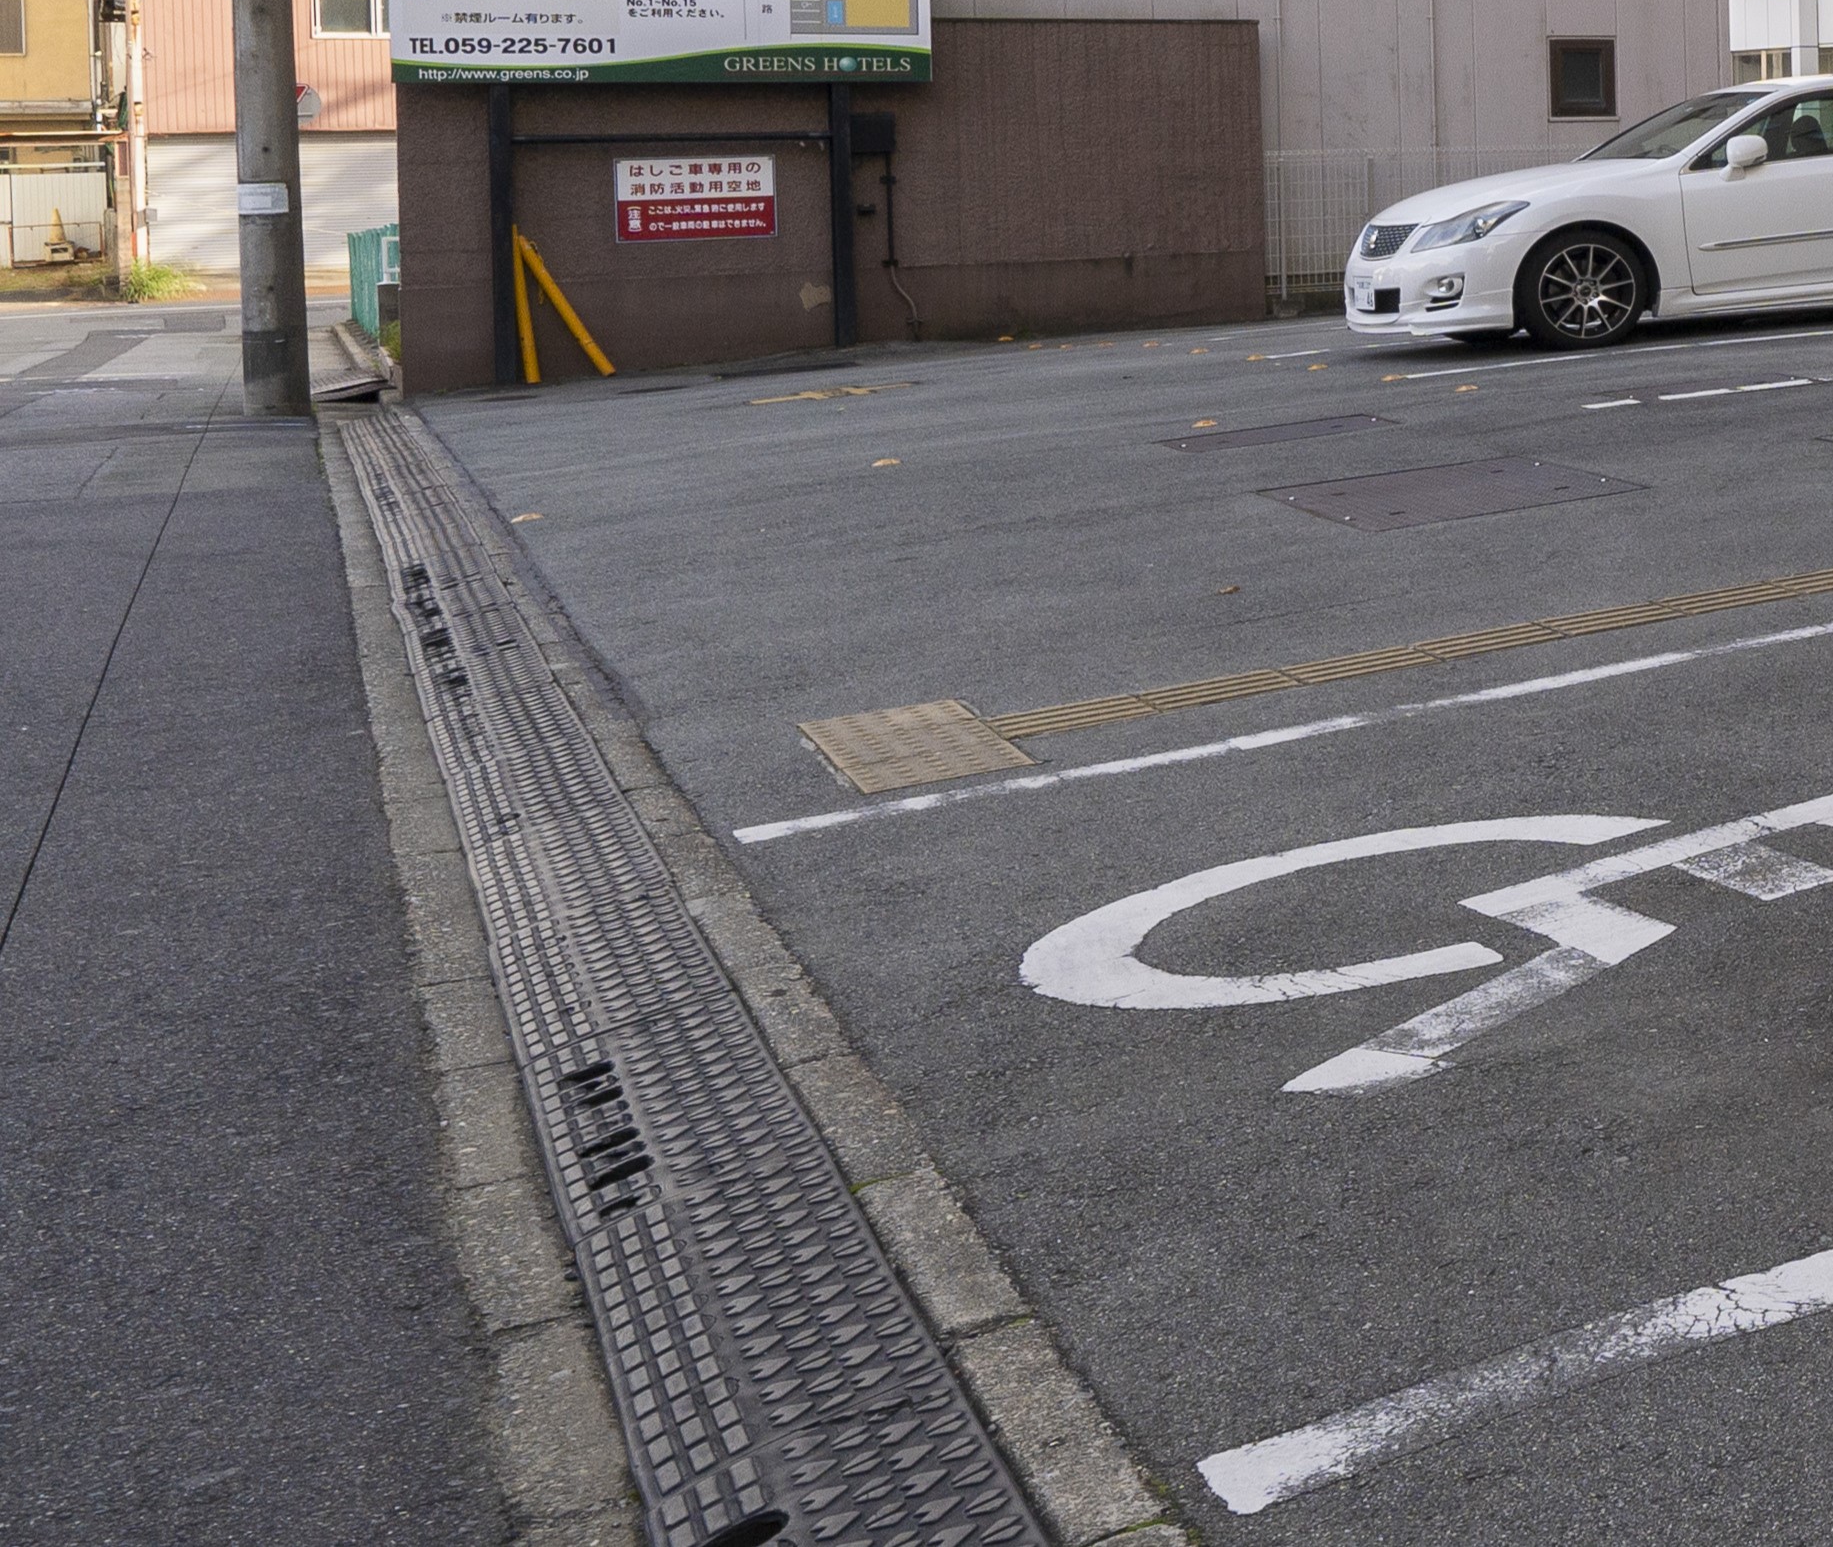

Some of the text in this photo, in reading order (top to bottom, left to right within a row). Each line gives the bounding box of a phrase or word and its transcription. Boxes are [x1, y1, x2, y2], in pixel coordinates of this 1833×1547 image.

[628, 8, 725, 18] をご利用ください。
[409, 37, 616, 55] TEL.059-225-7601
[723, 55, 815, 72] GREENS
[418, 68, 589, 82] http://www.greens.co.jp
[629, 162, 761, 178] はしご車専用の
[630, 180, 762, 196] 消防活動用空地
